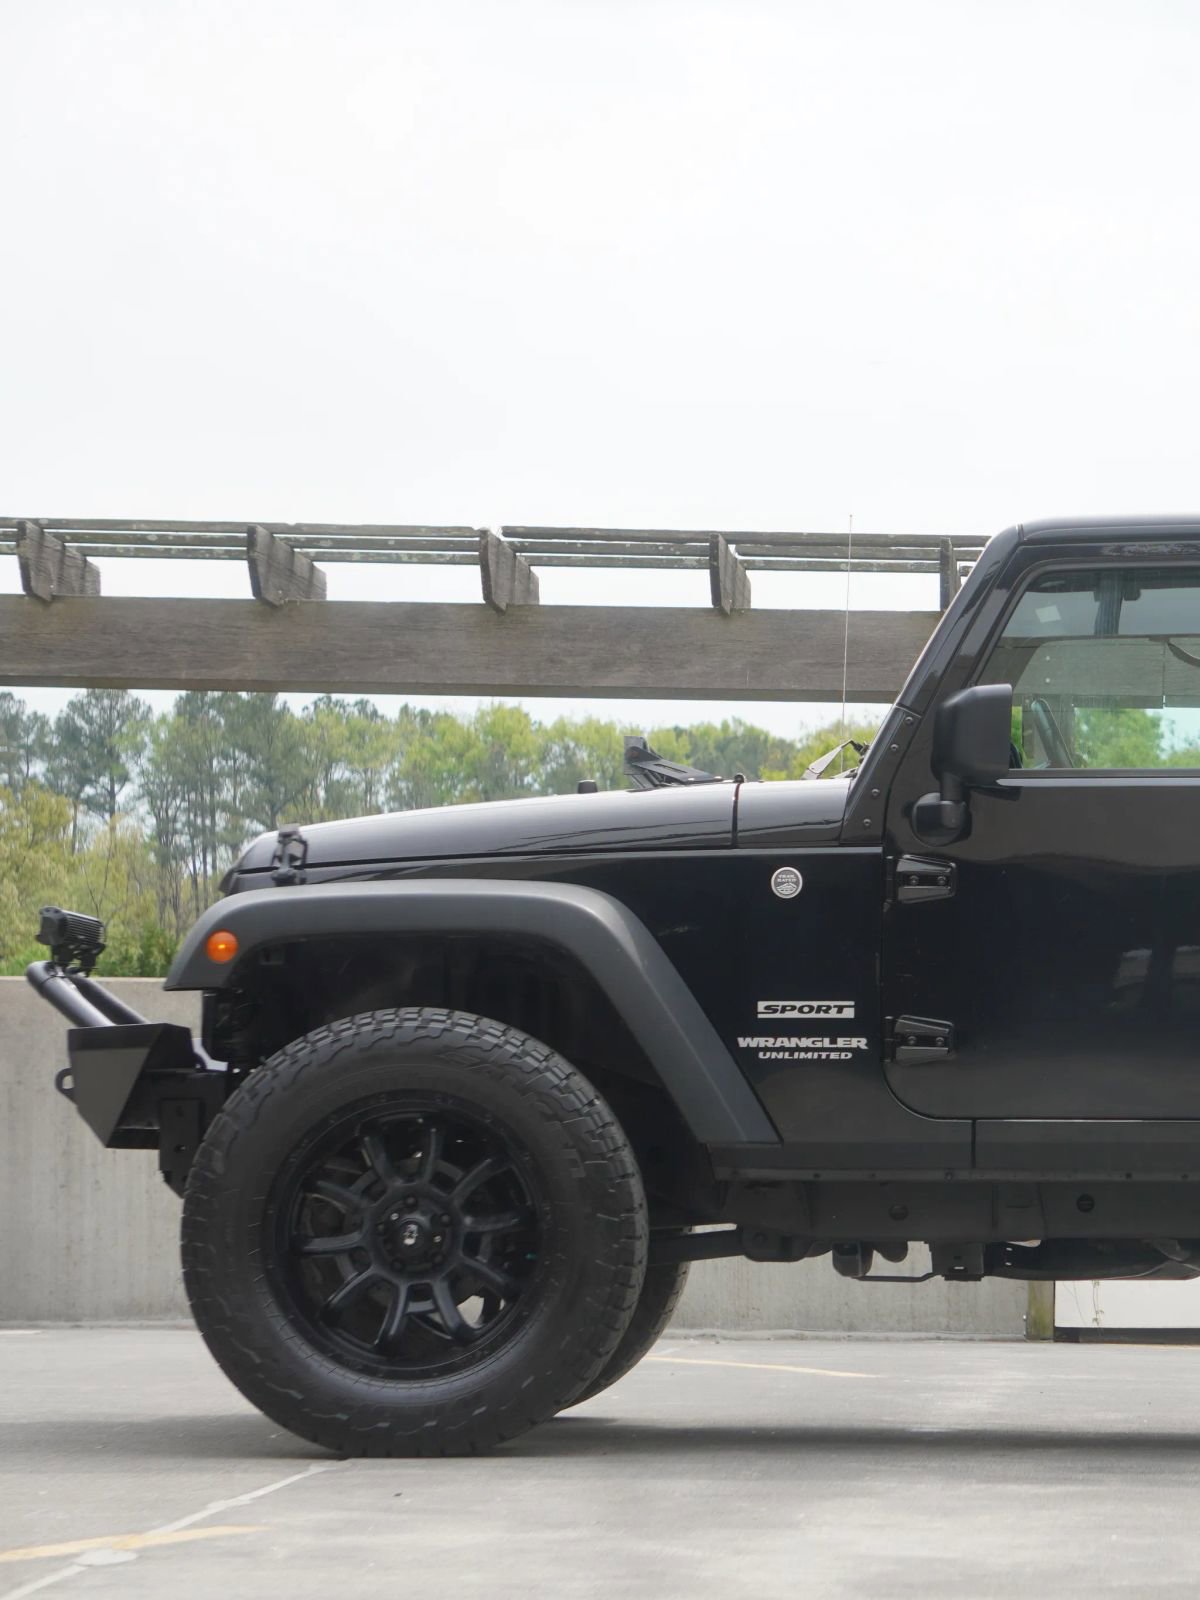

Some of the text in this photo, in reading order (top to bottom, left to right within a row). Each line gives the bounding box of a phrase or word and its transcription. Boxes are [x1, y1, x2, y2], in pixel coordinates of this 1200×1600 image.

[757, 1004, 855, 1015] SPORT
[738, 1037, 868, 1049] WRANGLER
[758, 1051, 852, 1060] UNLIMITED
